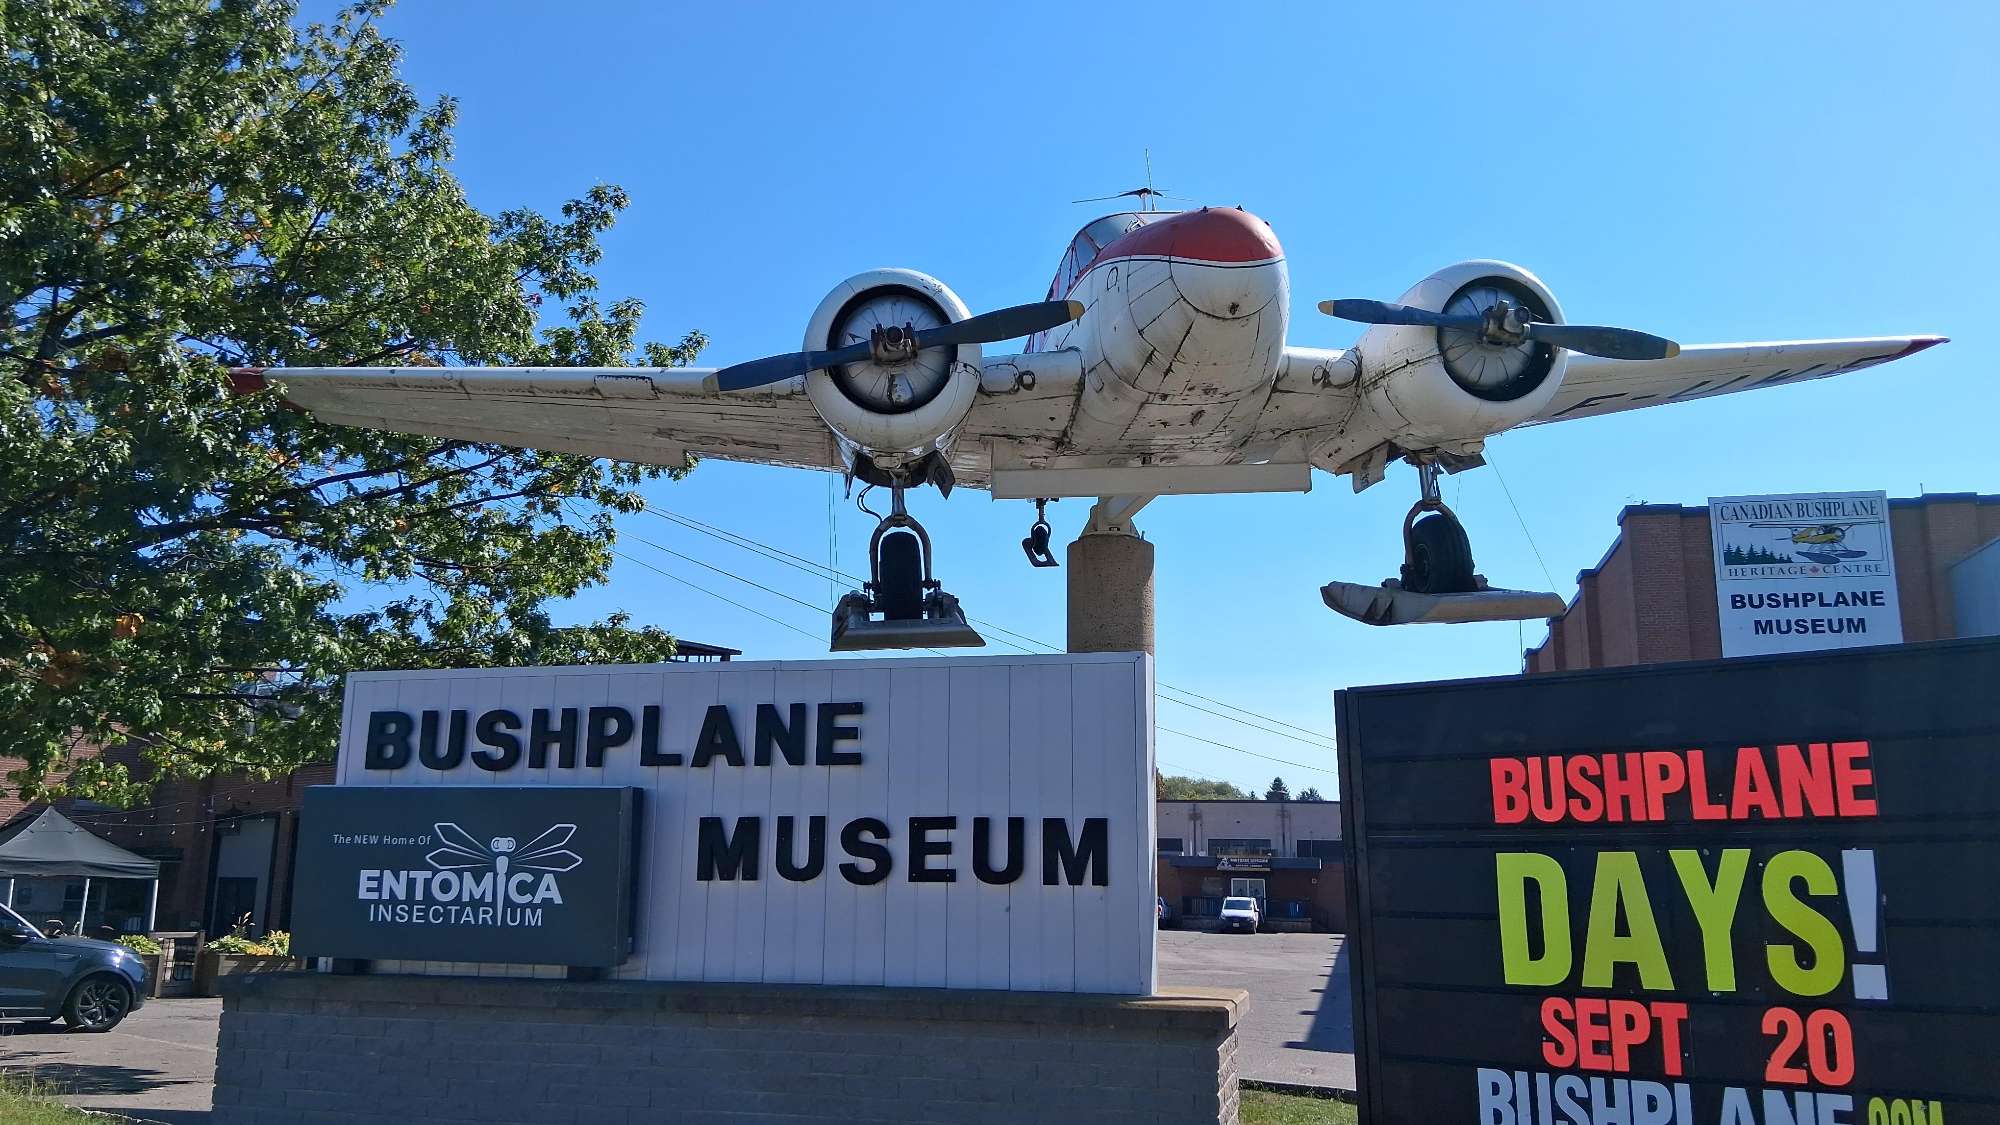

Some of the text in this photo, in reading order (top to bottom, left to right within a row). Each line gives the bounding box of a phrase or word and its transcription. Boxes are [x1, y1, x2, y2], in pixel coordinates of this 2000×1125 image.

[1720, 500, 1879, 521] CANADIAN BUSHPLANE
[1729, 564, 1882, 577] HERITAGE CENTRE
[1731, 591, 1886, 609] BUSHPLANE
[1754, 618, 1867, 635] MUSEUM
[365, 702, 863, 770] BUSHPLANE
[1490, 741, 1878, 824] BUSHPLANE
[333, 834, 432, 845] The NEW Home Of
[697, 816, 1109, 886] MUSEUM
[358, 869, 563, 904] ENTOMICA
[369, 904, 542, 927] INSECTARIUM
[1496, 848, 1889, 1000] DAYS!
[1541, 997, 1855, 1086] SEPT 20
